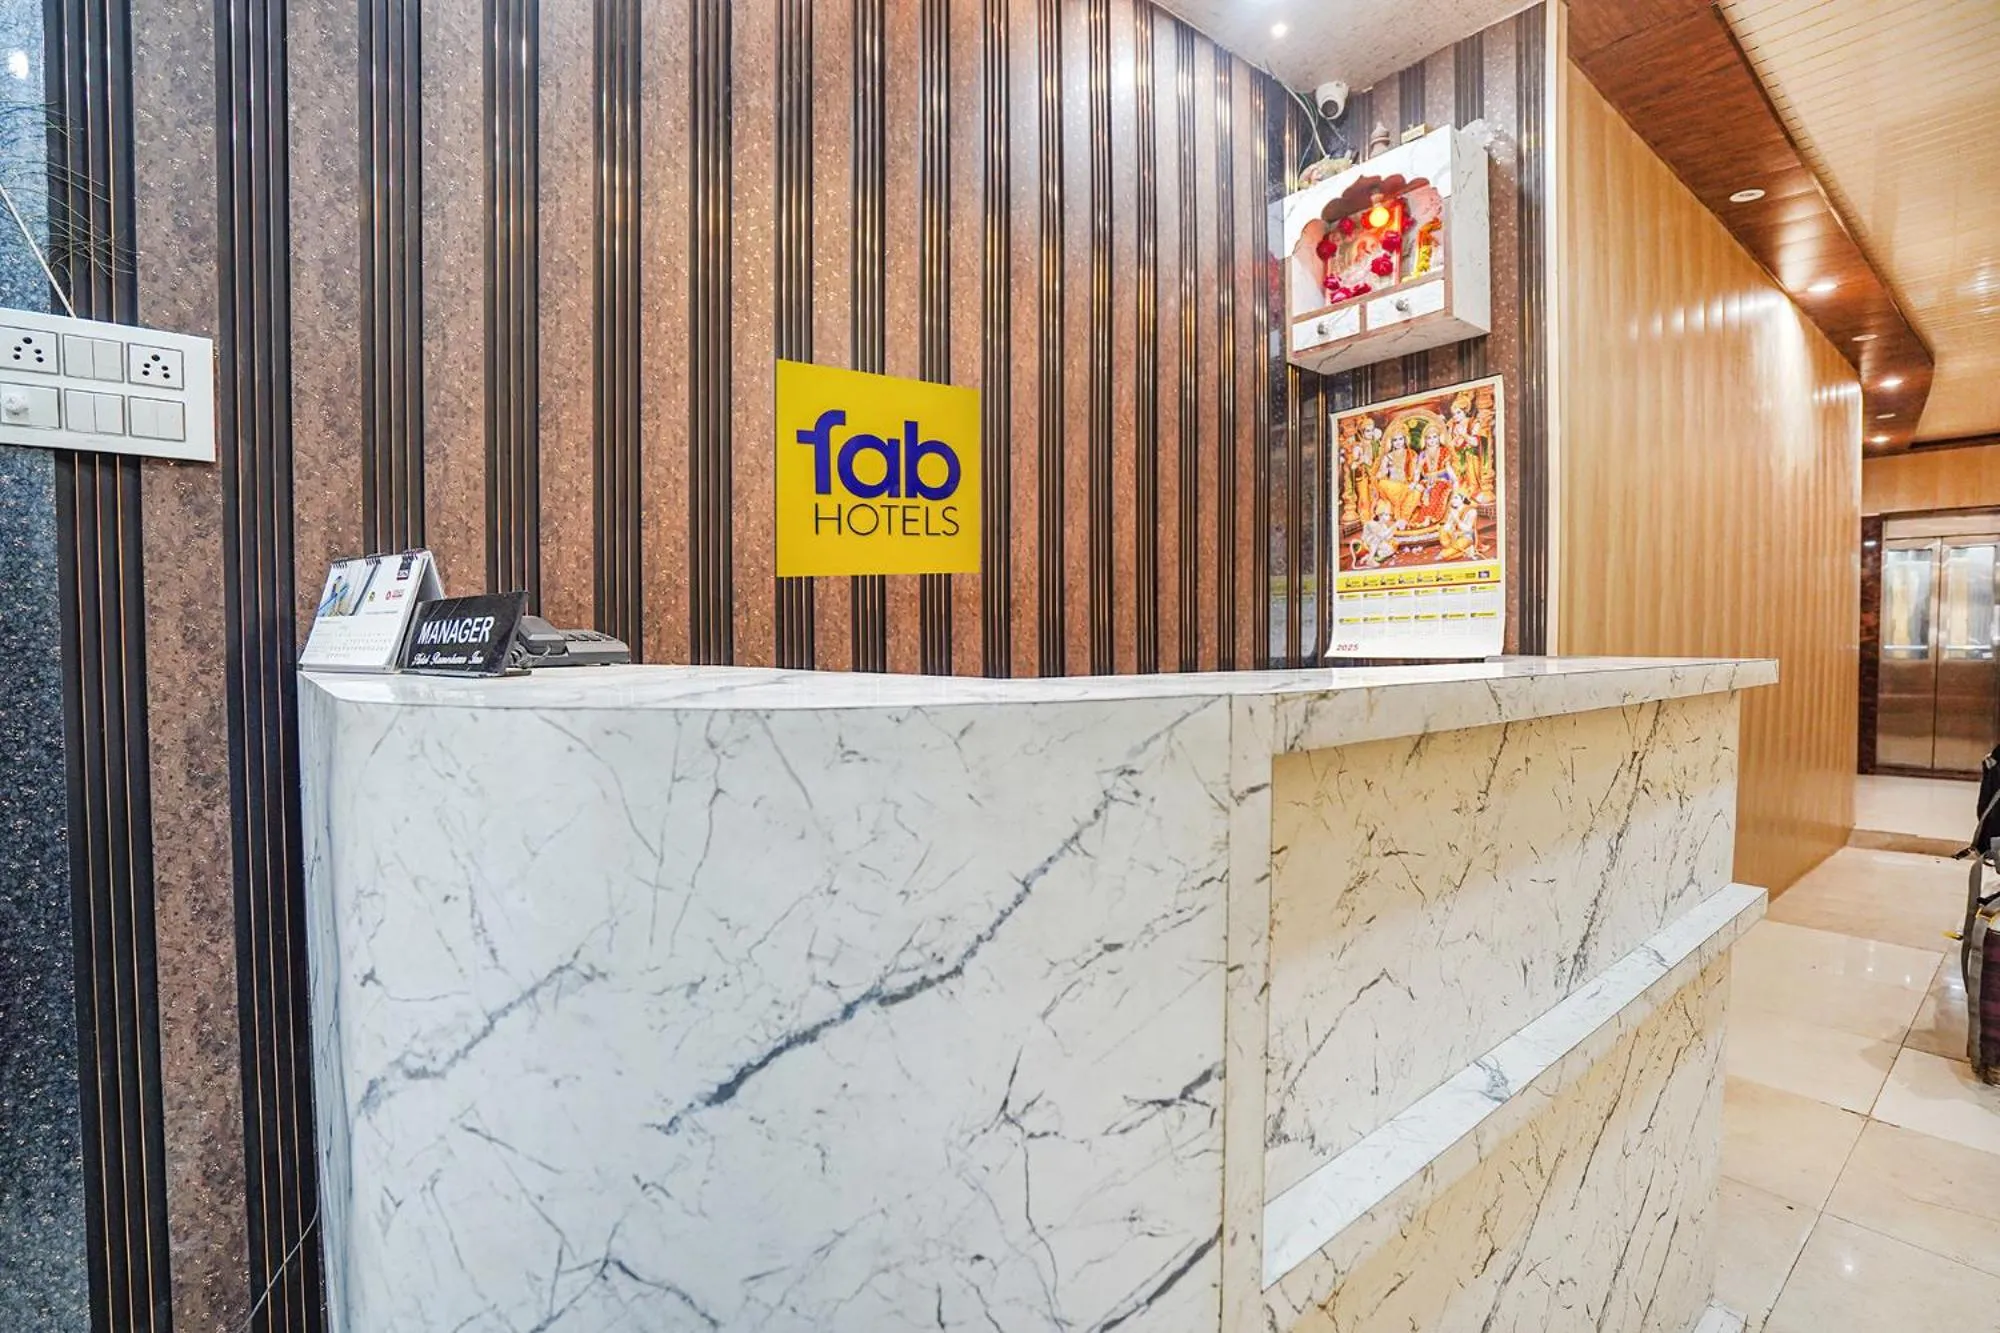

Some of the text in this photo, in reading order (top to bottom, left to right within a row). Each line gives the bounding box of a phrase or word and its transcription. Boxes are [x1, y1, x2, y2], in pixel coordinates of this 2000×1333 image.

[796, 409, 961, 501] fab
[814, 502, 960, 537] HOTELS
[416, 616, 495, 645] MANAGER
[1336, 642, 1360, 652] 2025
